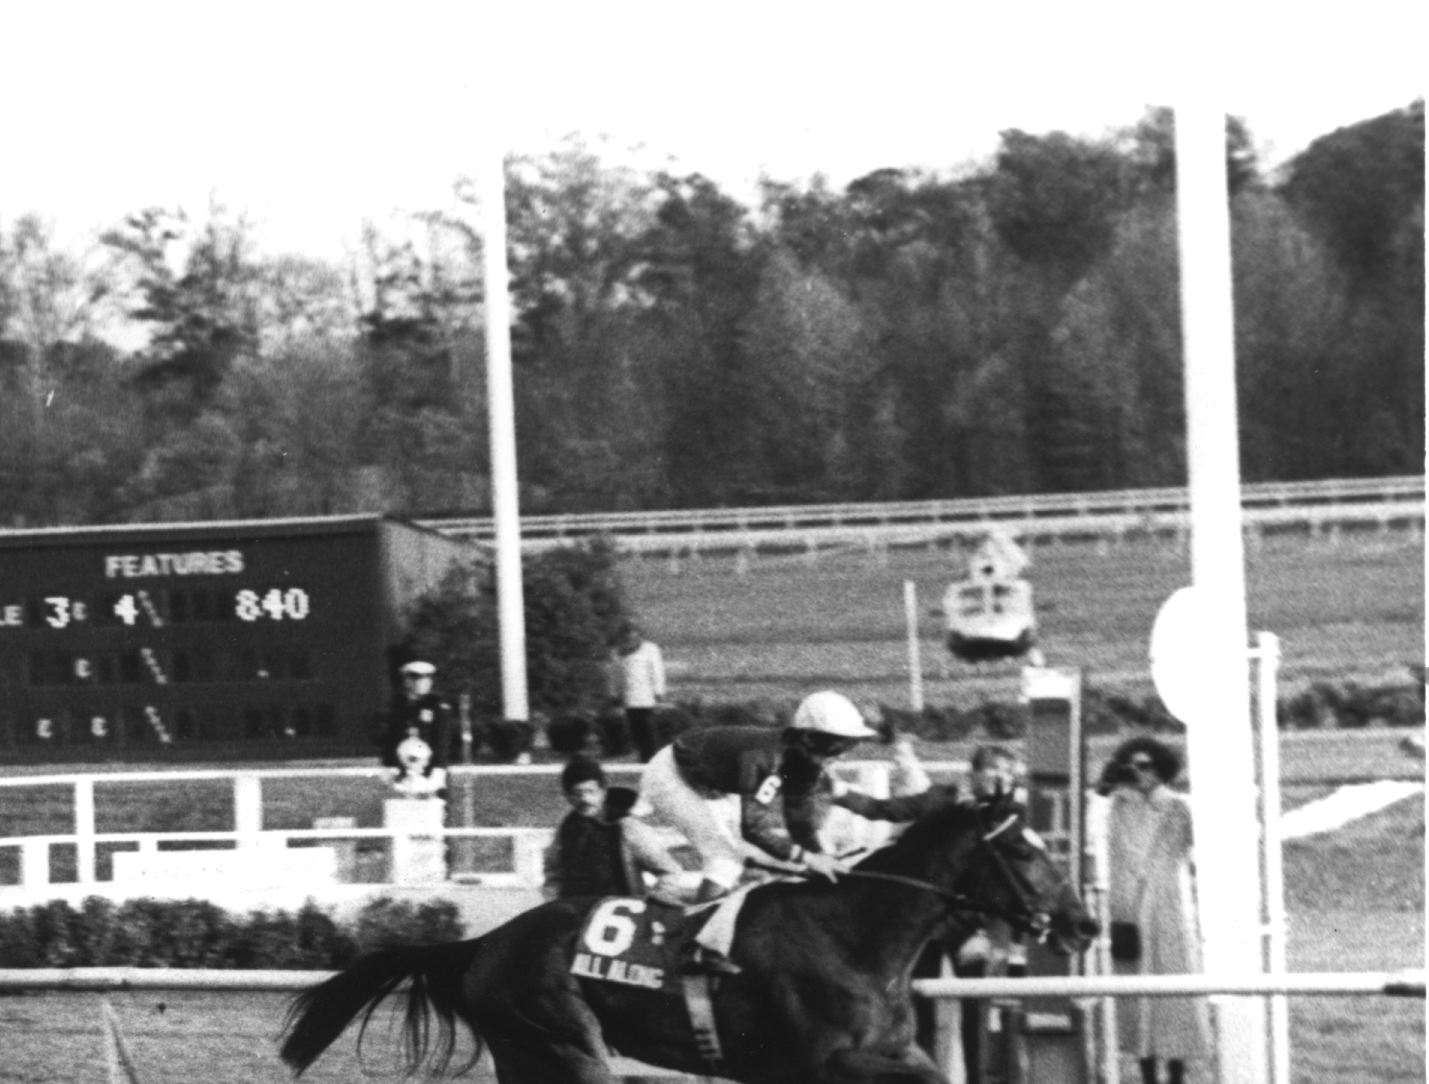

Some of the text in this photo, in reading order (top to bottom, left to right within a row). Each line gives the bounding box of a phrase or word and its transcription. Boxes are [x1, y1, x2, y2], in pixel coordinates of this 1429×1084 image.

[107, 551, 245, 578] FEATURES
[46, 598, 70, 629] 3
[116, 594, 141, 626] 4
[756, 776, 781, 804] 6
[584, 899, 646, 957] 6
